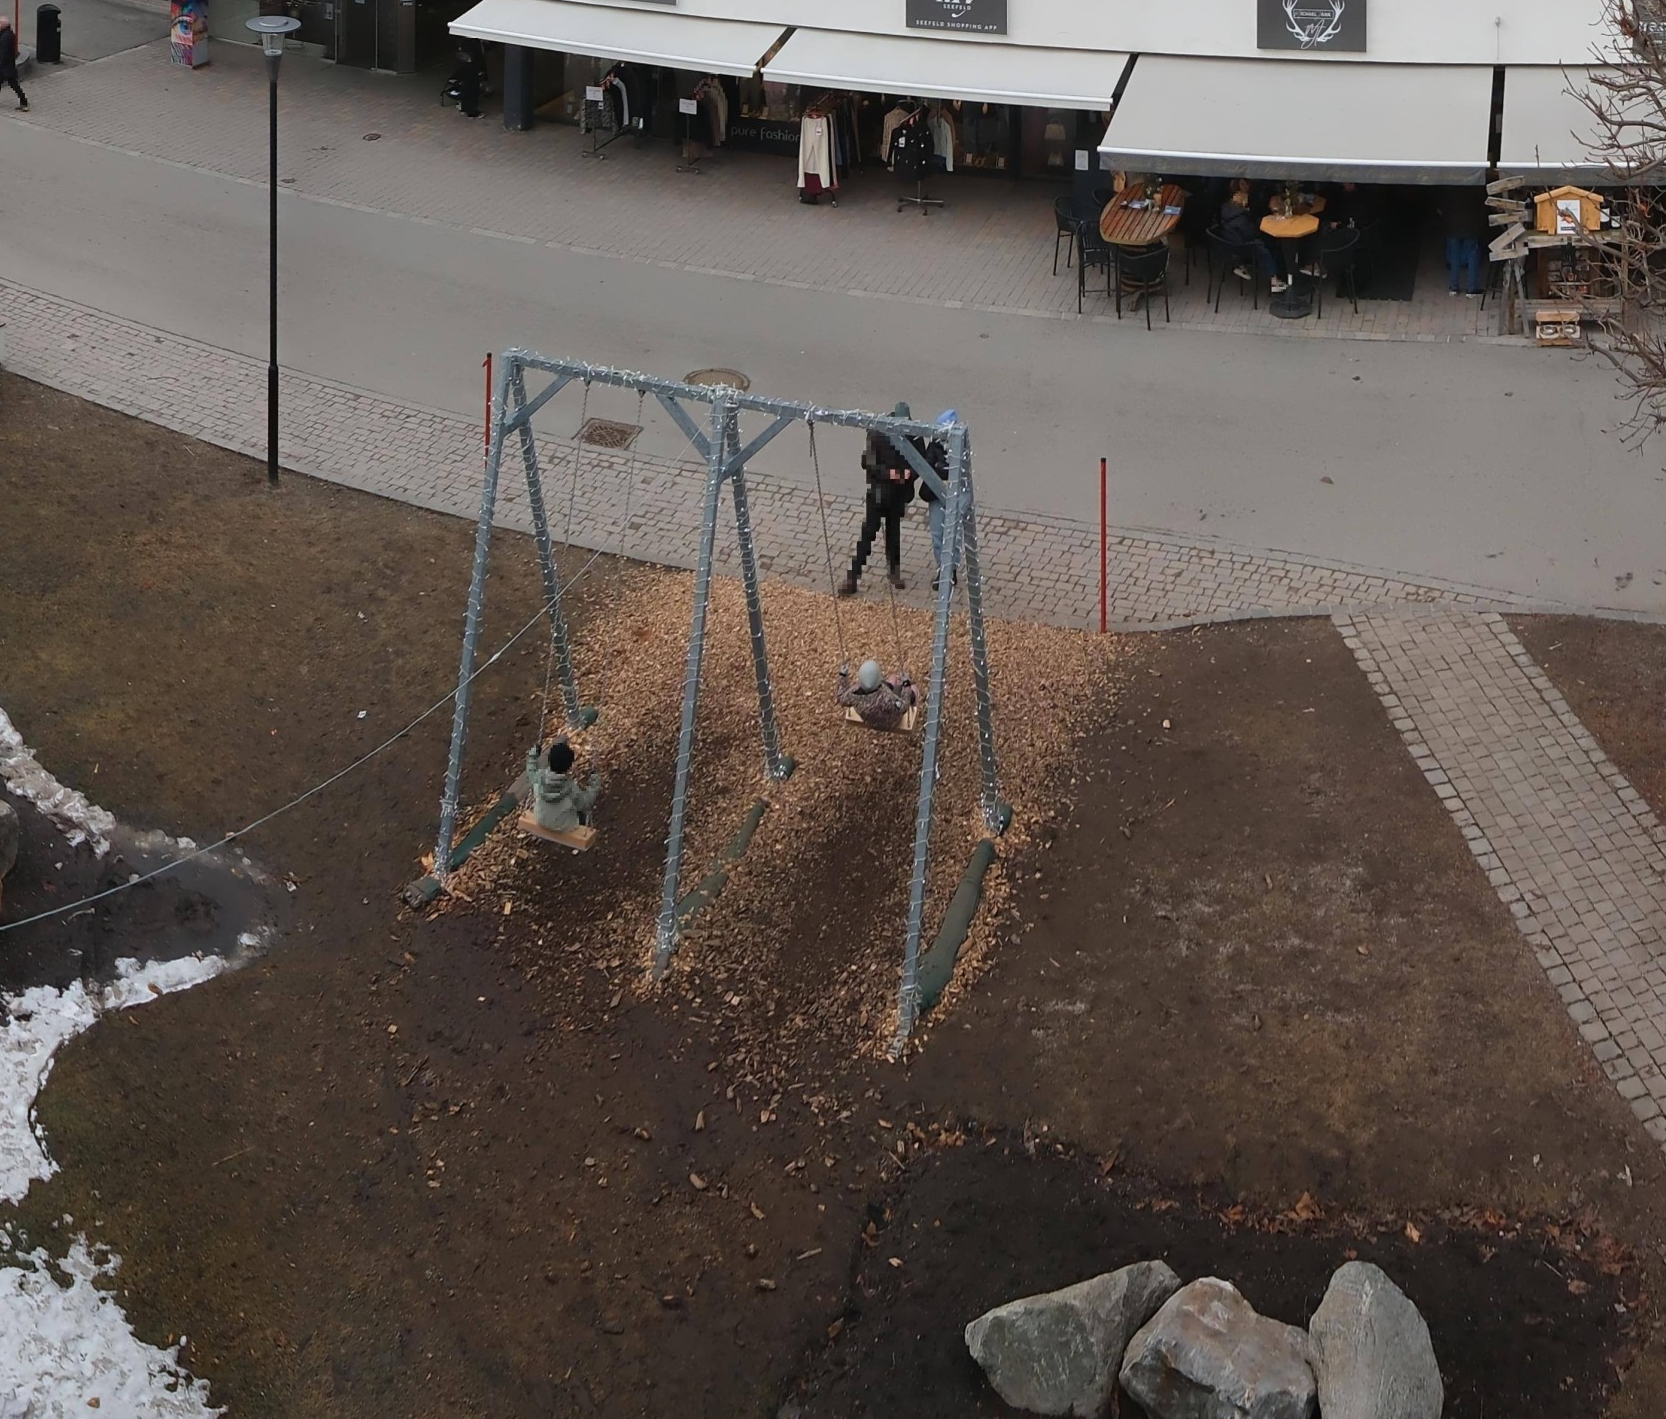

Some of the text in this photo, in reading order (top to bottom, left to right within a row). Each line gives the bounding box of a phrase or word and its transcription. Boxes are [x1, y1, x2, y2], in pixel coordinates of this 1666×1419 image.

[943, 3, 972, 11] SEEFELD
[947, 22, 982, 30] SHOPPING
[731, 125, 756, 137] pure
